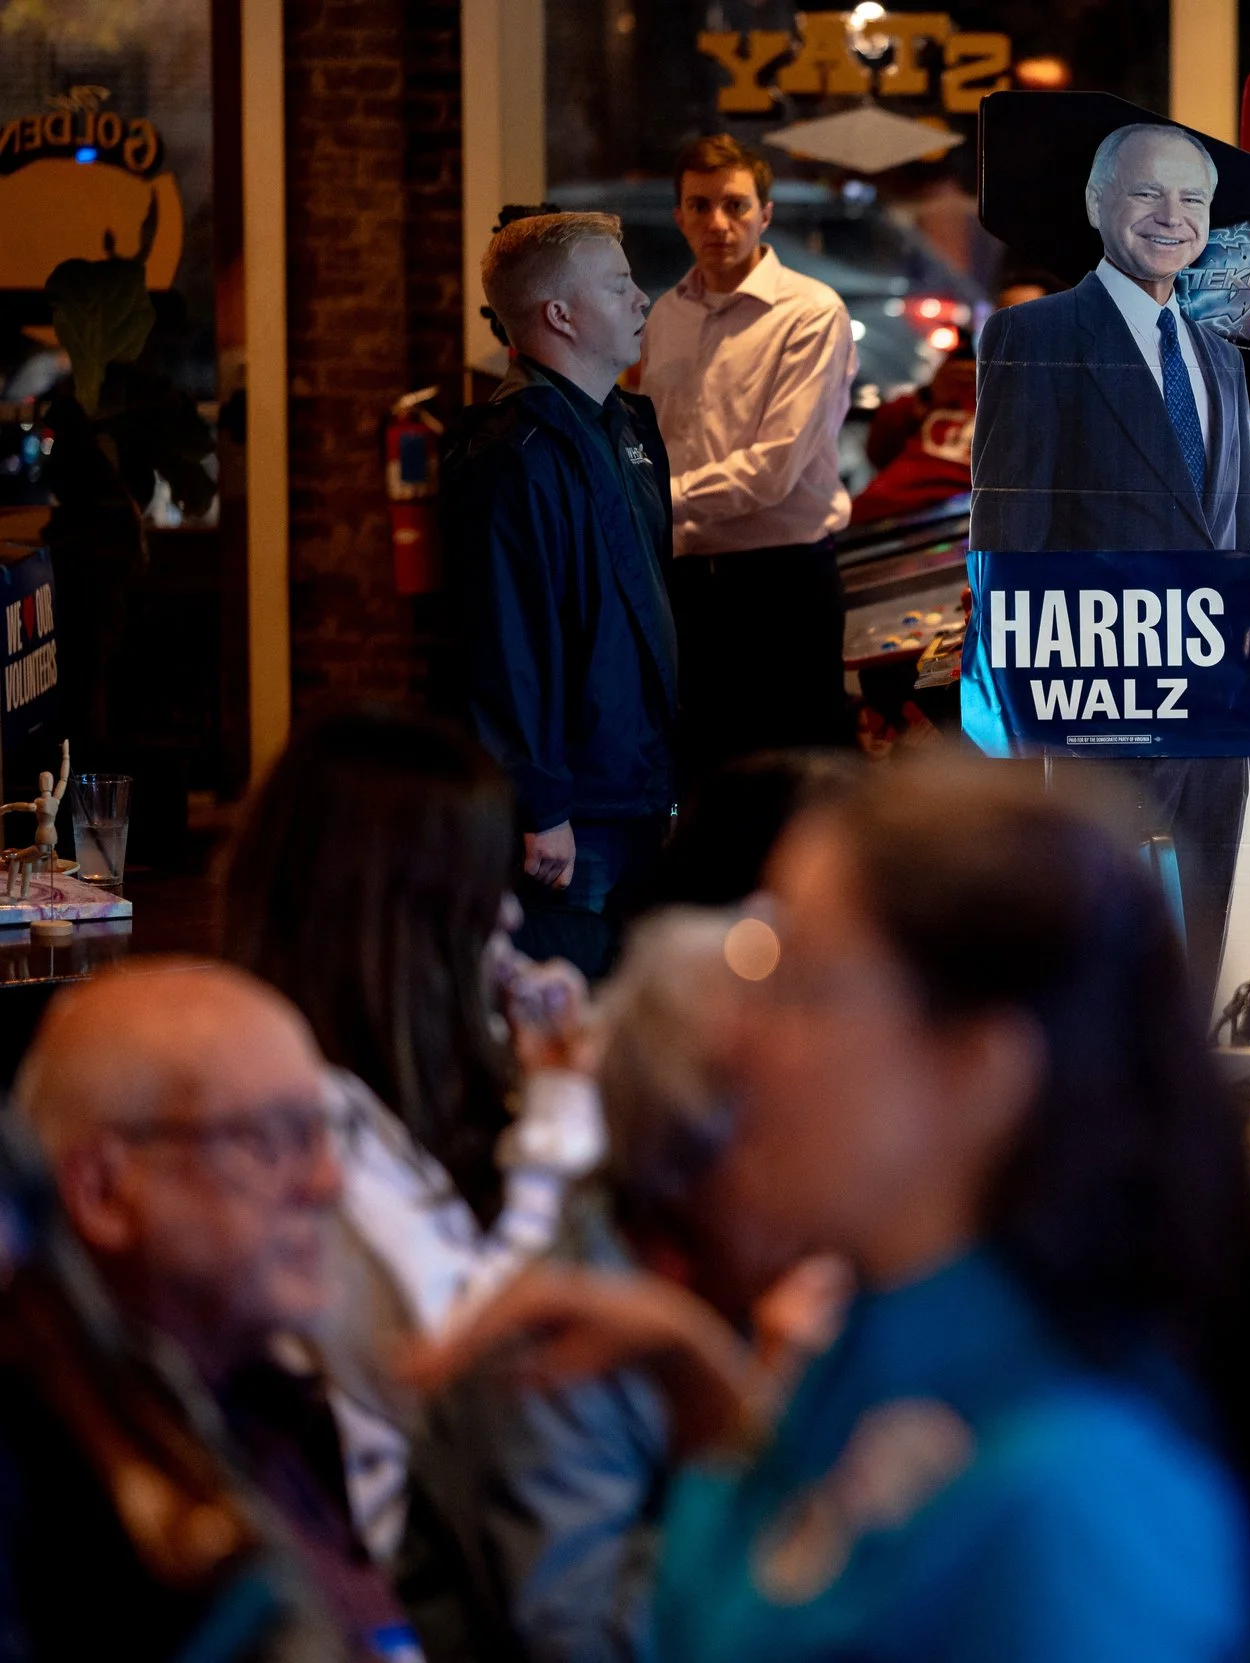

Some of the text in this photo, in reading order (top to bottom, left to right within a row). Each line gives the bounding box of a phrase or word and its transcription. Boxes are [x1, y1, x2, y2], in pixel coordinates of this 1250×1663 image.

[6, 583, 54, 656] WE OUR
[990, 587, 1226, 669] HARRIS
[5, 638, 58, 712] VOLUNTEERS
[1029, 678, 1189, 721] WALZ
